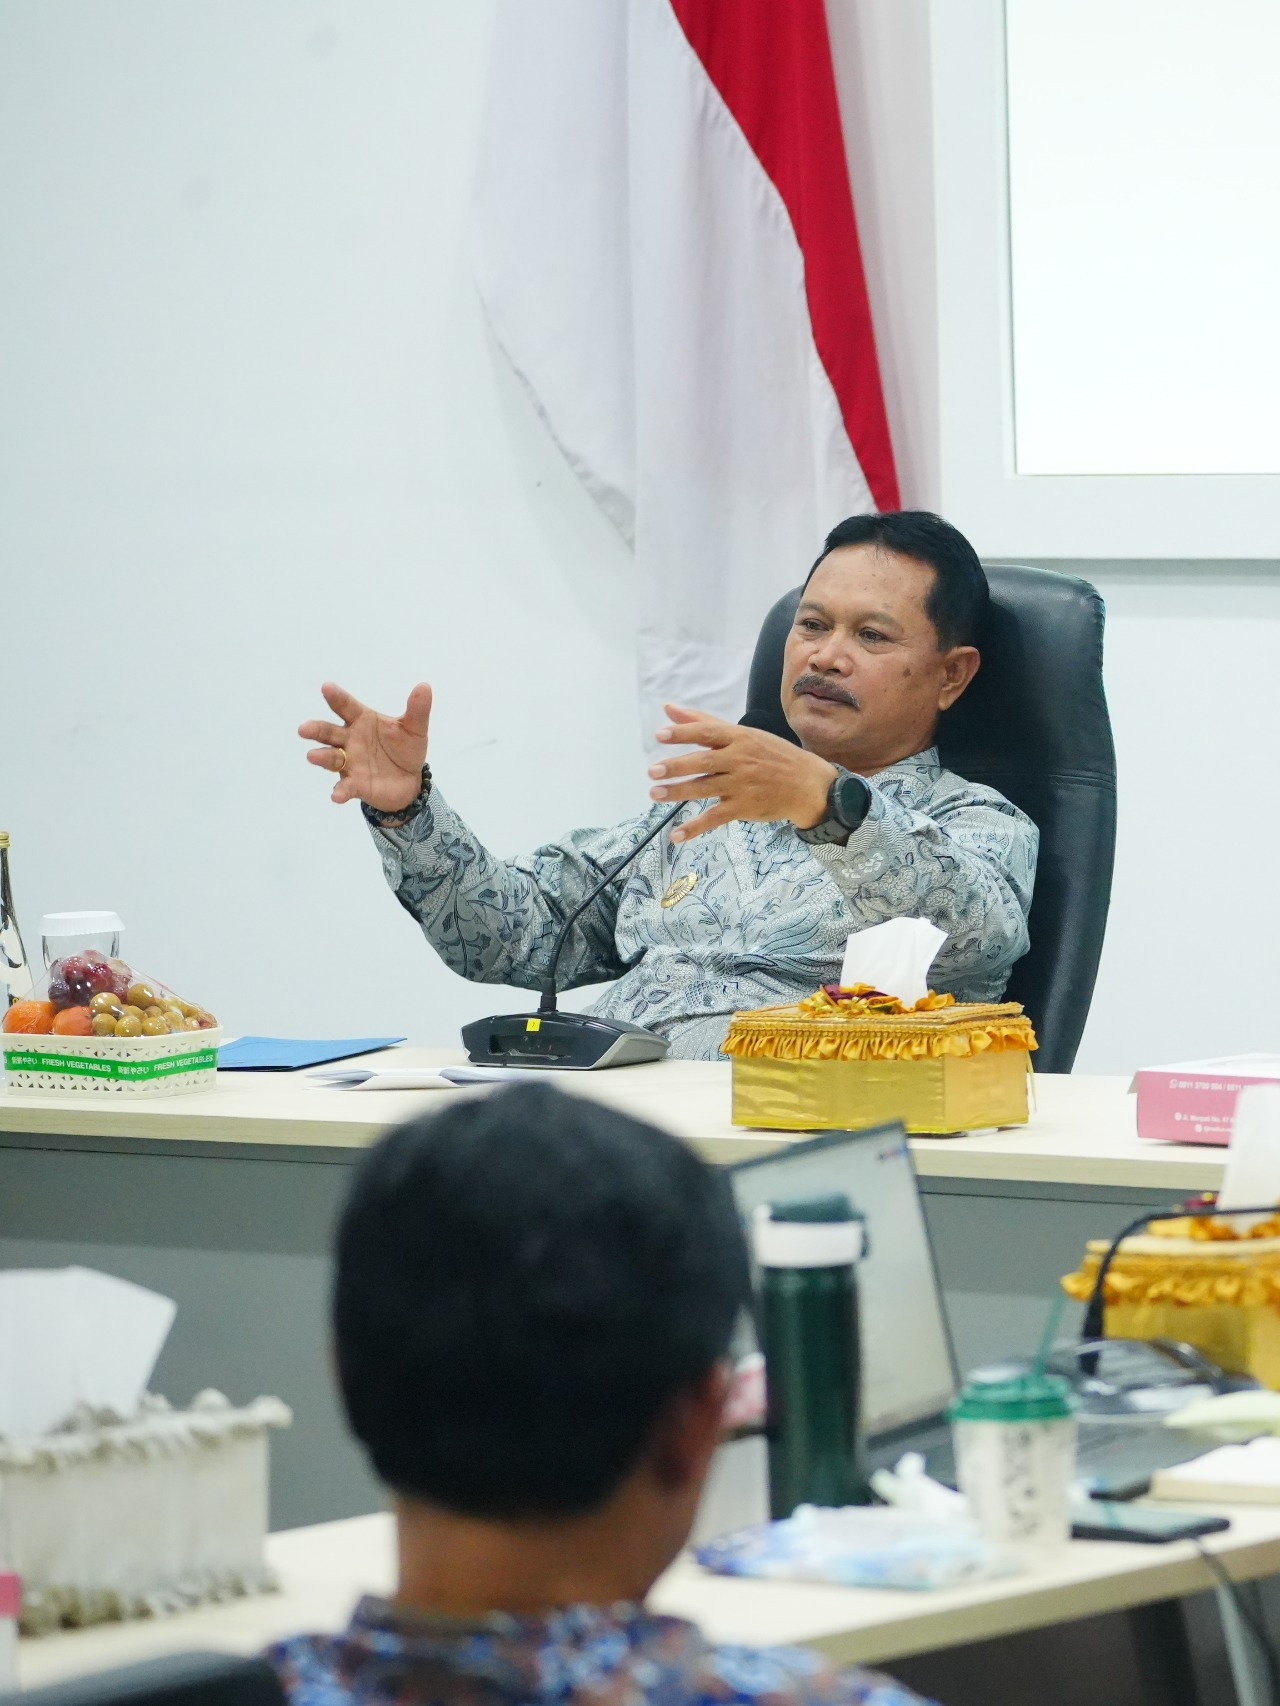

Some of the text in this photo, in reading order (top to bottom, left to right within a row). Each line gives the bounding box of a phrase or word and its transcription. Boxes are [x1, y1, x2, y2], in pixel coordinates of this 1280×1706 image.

[41, 1058, 112, 1073] FRESH VEGETABLES
[153, 1054, 214, 1072] FRESH VEGETABLES
